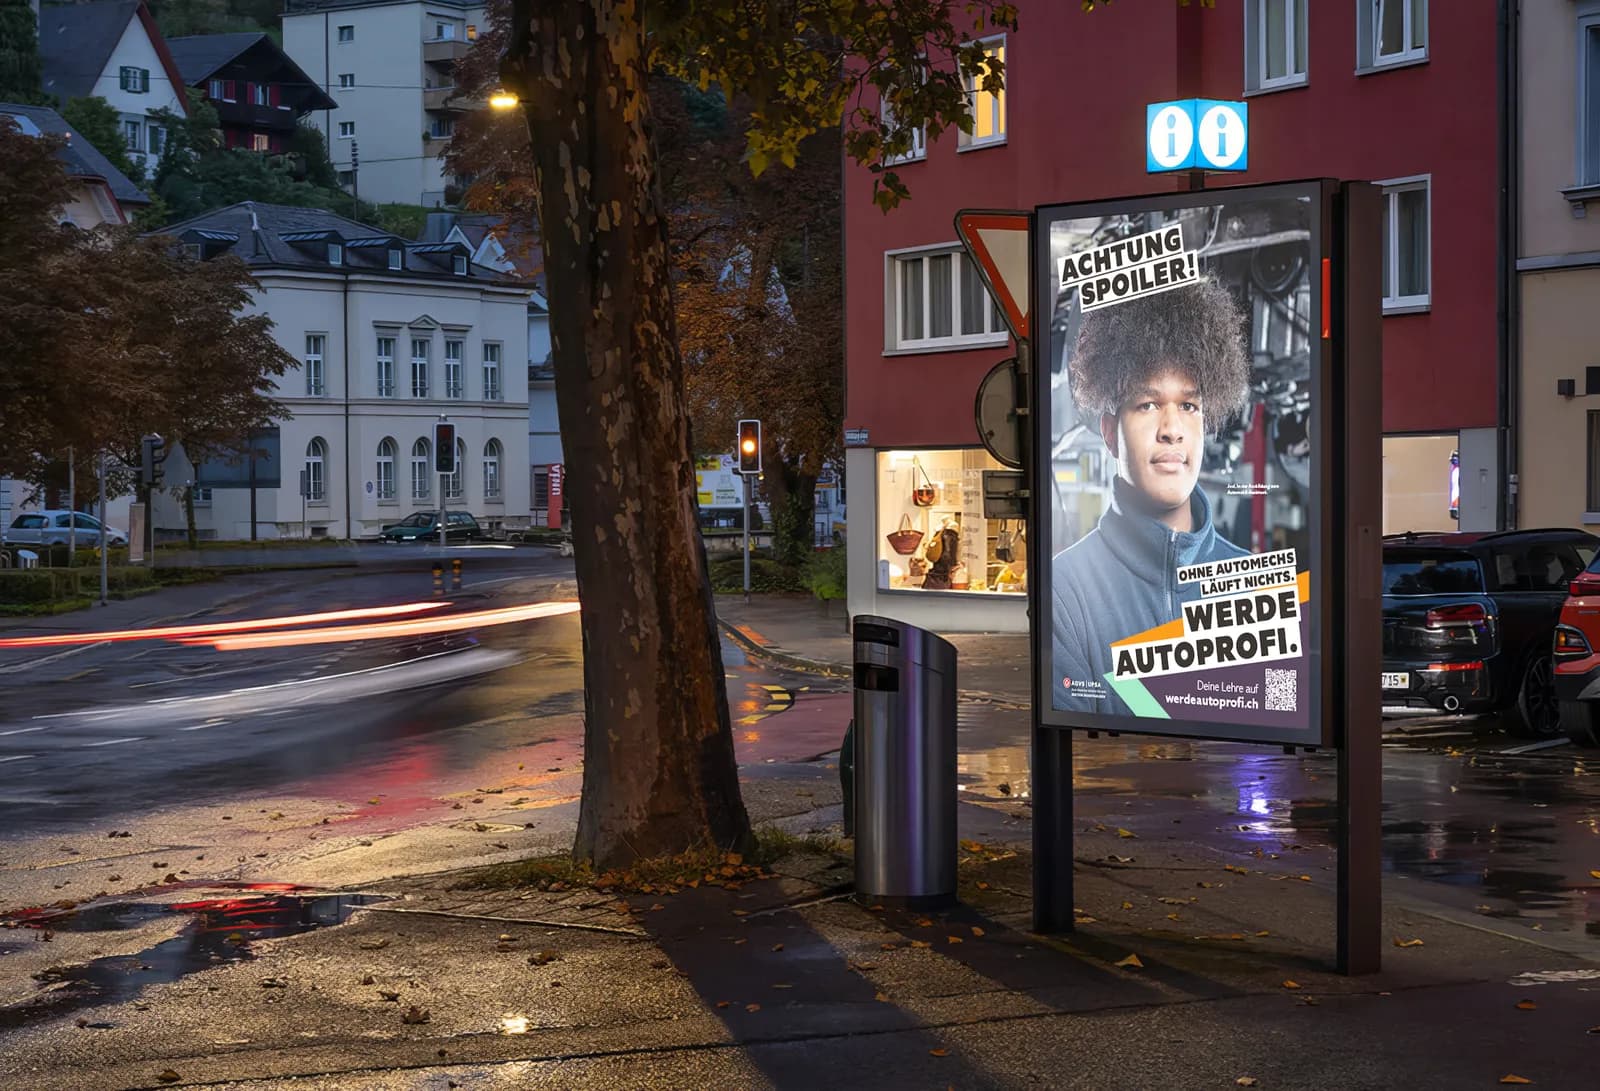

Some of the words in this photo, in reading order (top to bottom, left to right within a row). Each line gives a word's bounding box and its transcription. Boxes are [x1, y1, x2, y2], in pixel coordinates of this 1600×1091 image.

[1062, 228, 1181, 282] ACHTUNG
[1081, 253, 1195, 305] SPOILER!
[1179, 565, 1213, 581] OHNE
[1216, 552, 1295, 575] AUTOMECHS
[1202, 578, 1241, 595] LÄUFT
[1245, 571, 1294, 588] NICHTS.
[1185, 591, 1297, 632] WERDE
[1116, 627, 1298, 676] AUTOPROFI.
[1165, 693, 1259, 709] werdeautoprofi.ch
[1197, 680, 1219, 692] Deine
[1221, 682, 1243, 693] Lehre
[1246, 684, 1259, 694] auf
